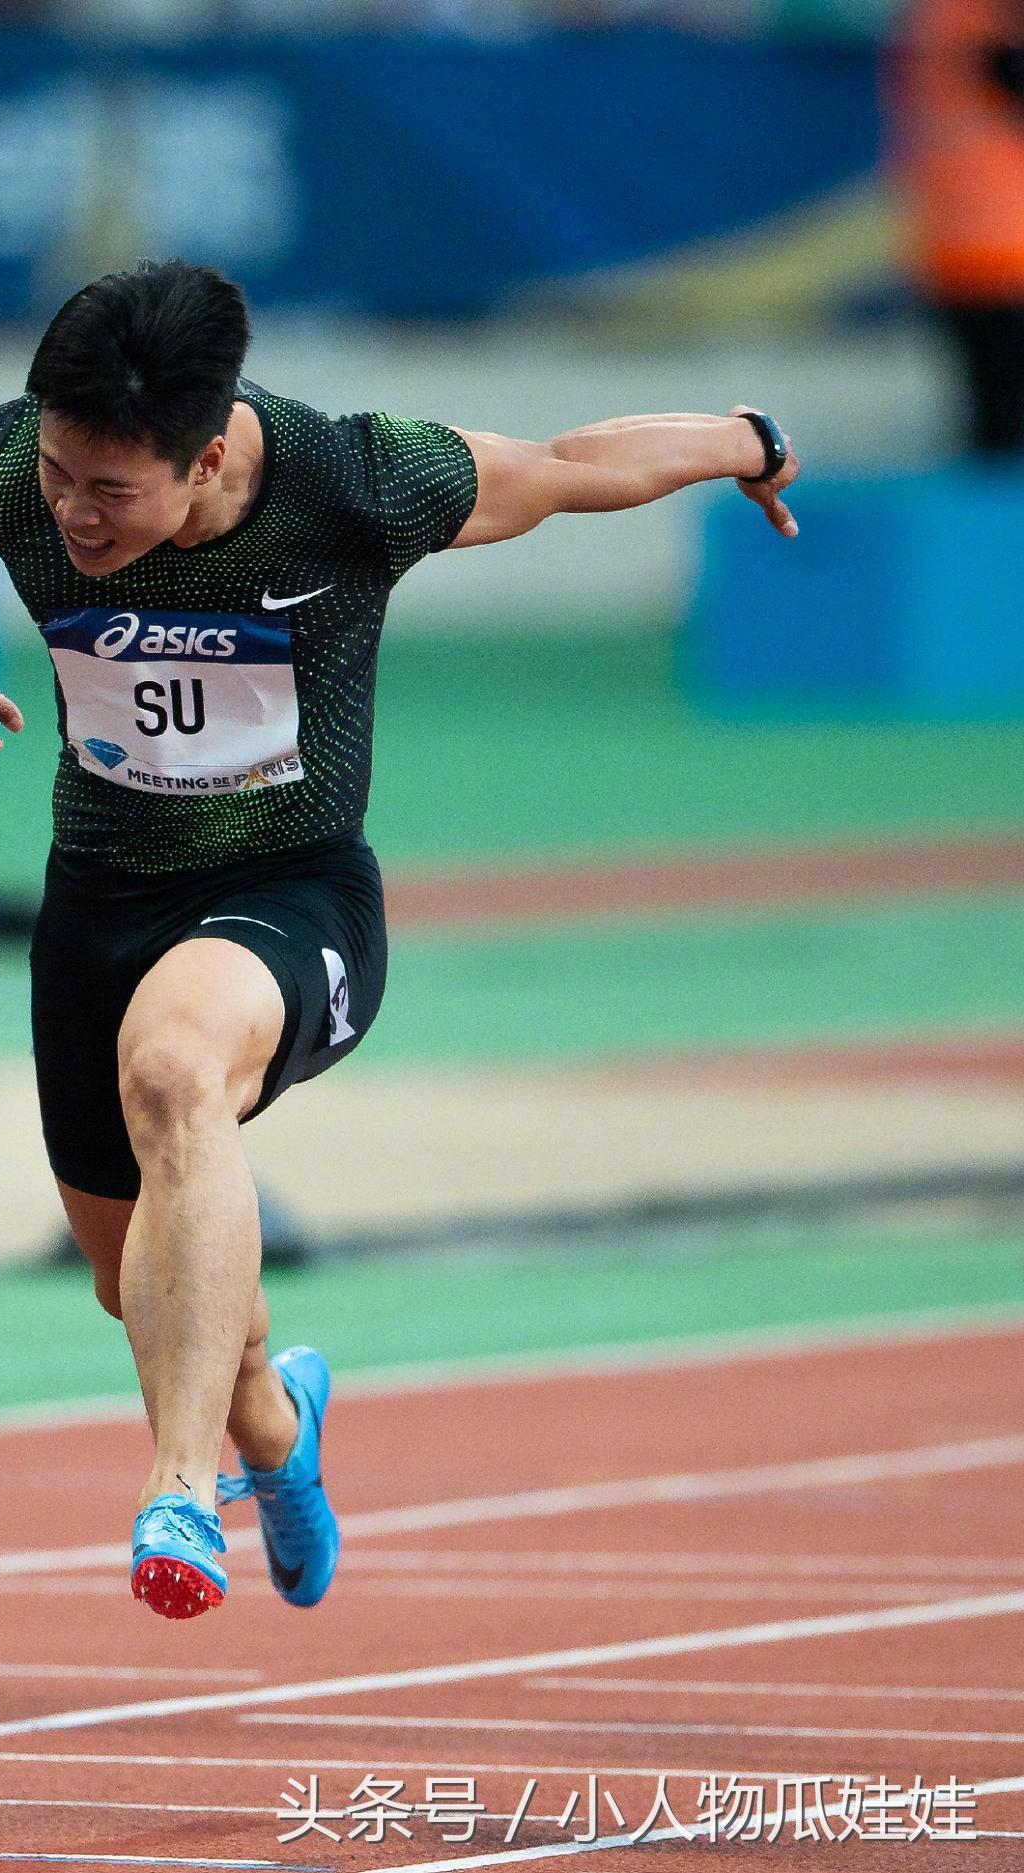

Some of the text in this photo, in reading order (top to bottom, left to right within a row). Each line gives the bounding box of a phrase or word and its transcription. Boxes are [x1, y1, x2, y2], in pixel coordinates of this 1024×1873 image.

[139, 625, 237, 657] asics
[133, 678, 206, 738] SU
[127, 767, 209, 790] MEETING
[213, 776, 231, 789] DE
